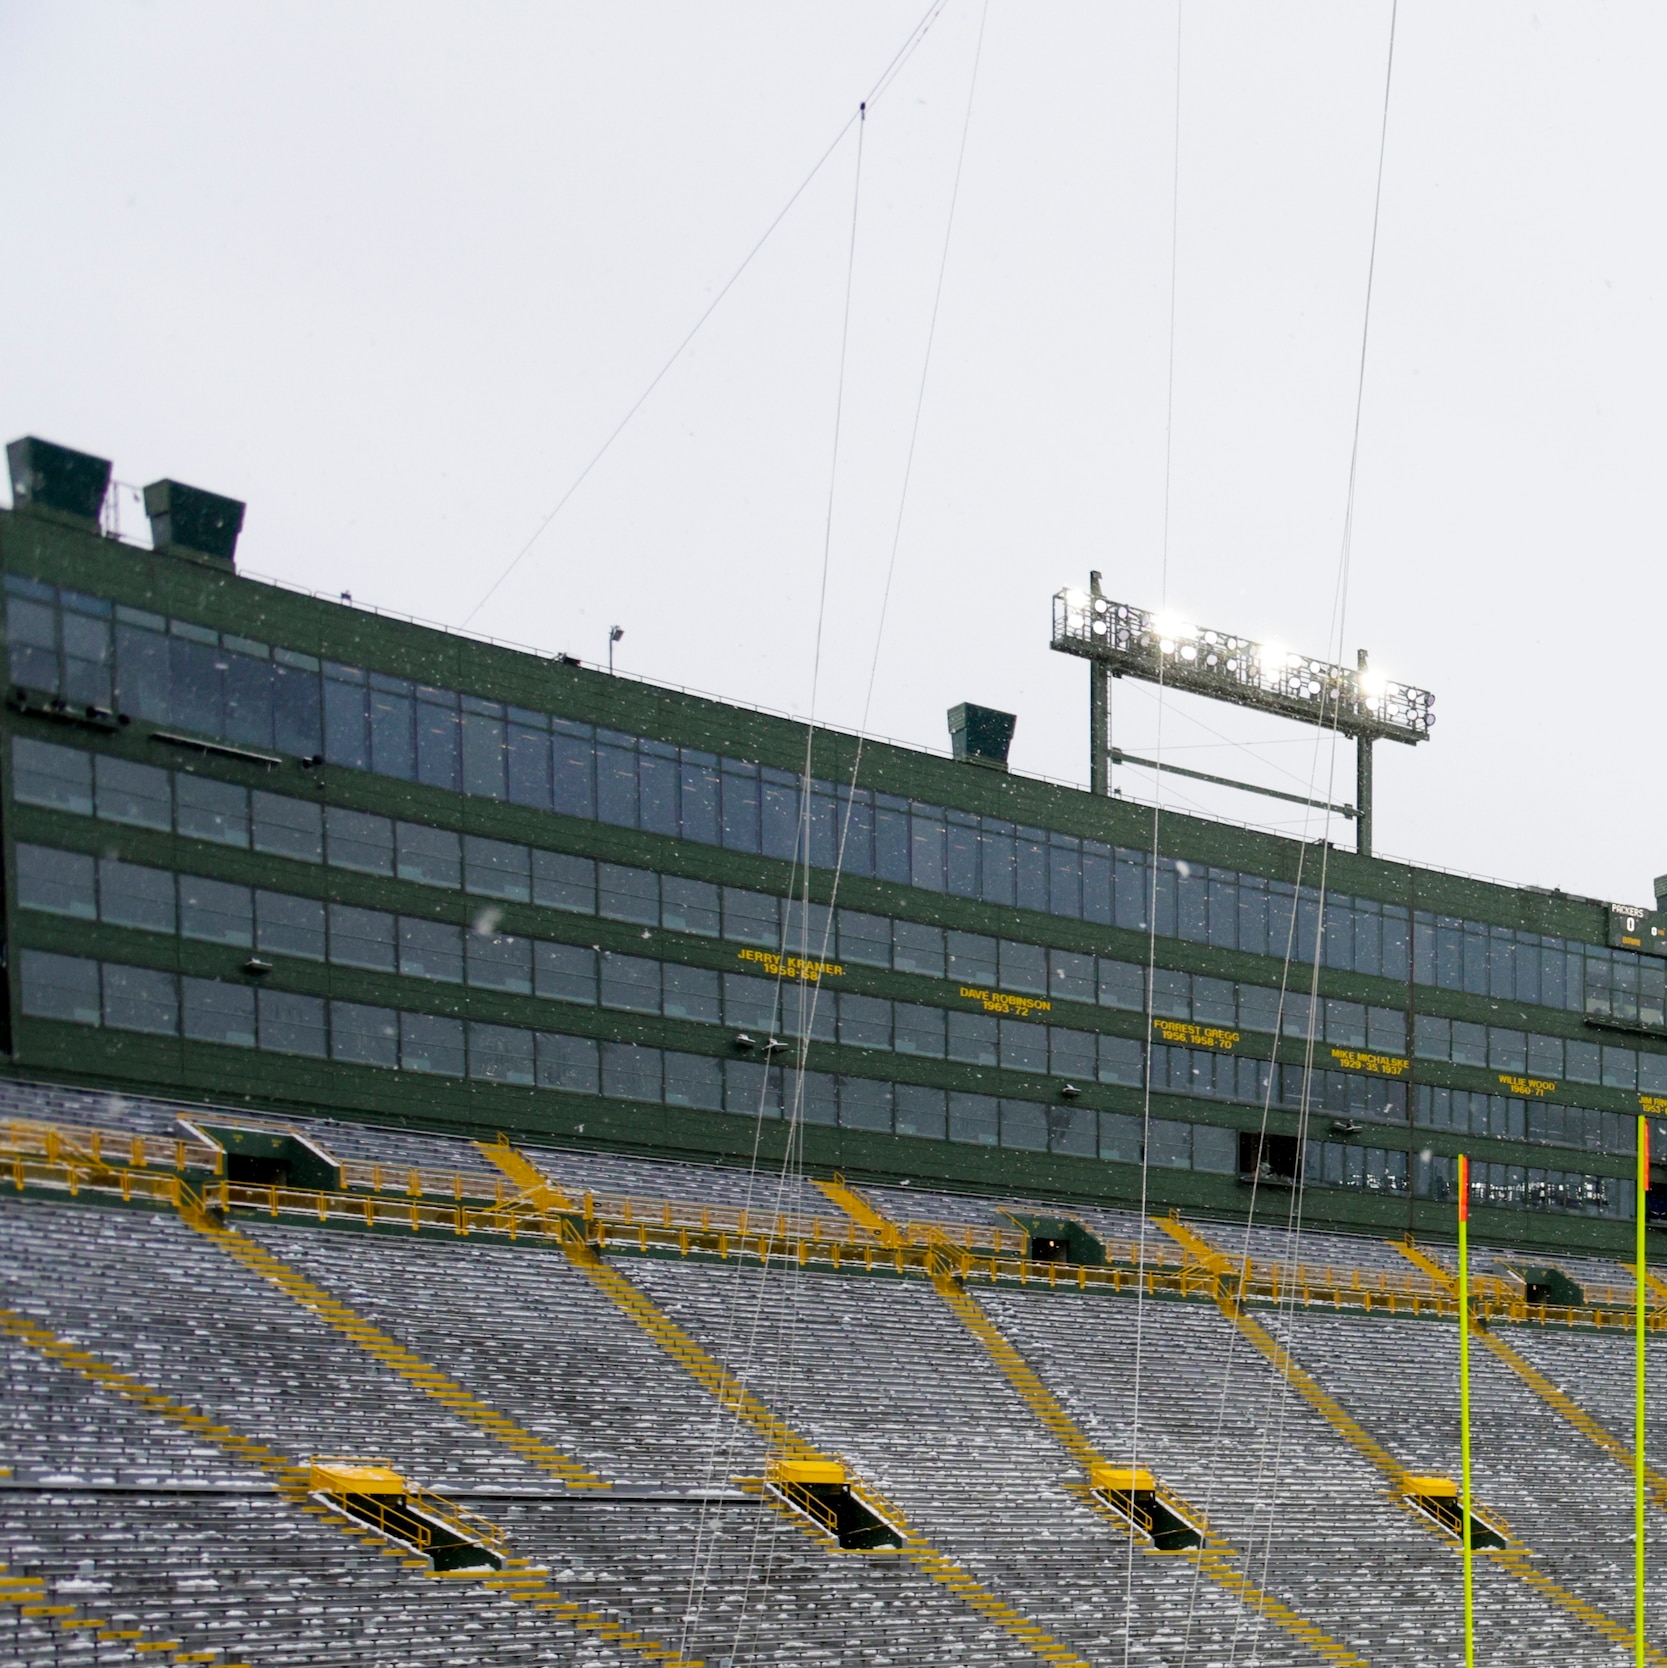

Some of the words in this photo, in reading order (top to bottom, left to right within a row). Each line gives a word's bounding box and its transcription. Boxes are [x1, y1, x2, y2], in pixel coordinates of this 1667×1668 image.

[1612, 904, 1644, 918] PACKERS
[1627, 917, 1635, 932] 0
[738, 949, 781, 965] JERRY
[788, 957, 843, 976] KRAMER
[960, 987, 989, 1001] DAVE
[992, 992, 1051, 1011] ROBINSON
[1154, 1020, 1200, 1035] FORREST
[1204, 1028, 1240, 1042] GREGG
[1331, 1049, 1355, 1060] MIKE
[1357, 1053, 1410, 1068] MICHALSKE
[1382, 1065, 1402, 1075] 1937
[1498, 1075, 1526, 1088] WILLIE
[1528, 1079, 1556, 1091] WOOD
[1639, 1096, 1652, 1106] JIM
